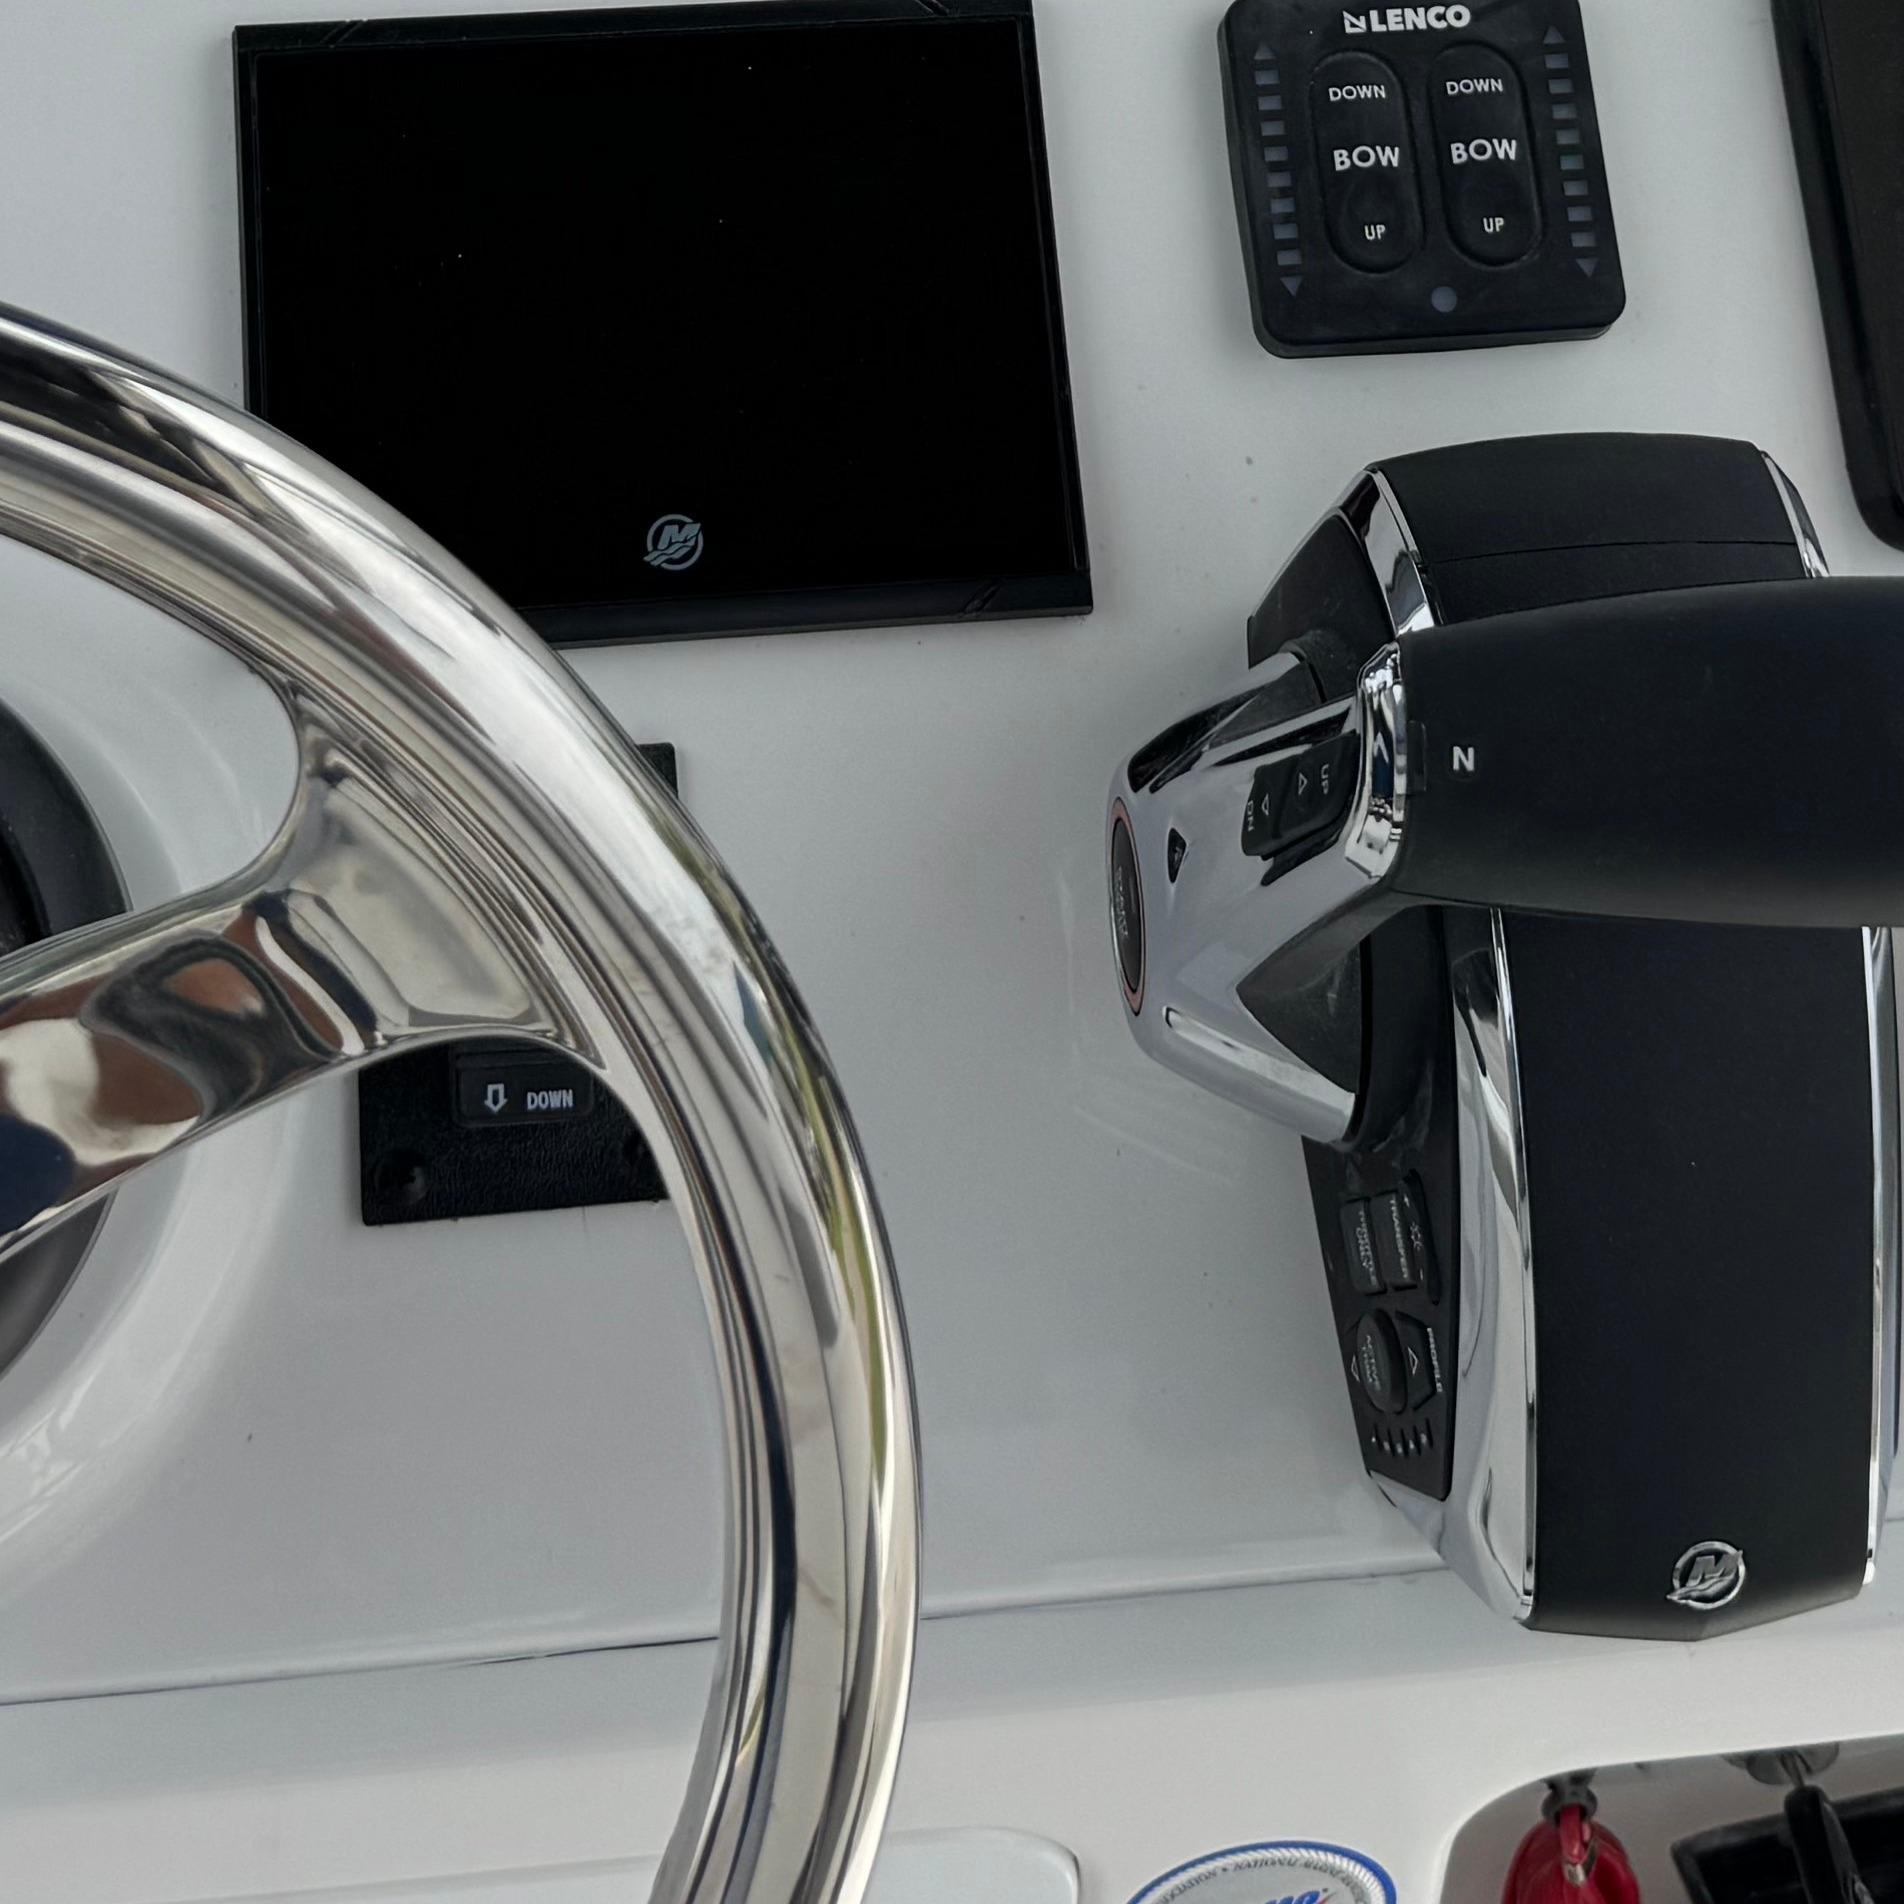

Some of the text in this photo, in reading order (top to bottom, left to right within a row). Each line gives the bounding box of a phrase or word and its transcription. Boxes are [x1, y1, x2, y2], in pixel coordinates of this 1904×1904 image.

[1371, 4, 1471, 33] LENCO
[1329, 84, 1386, 102] DOWN
[1446, 78, 1503, 95] DOWN
[1333, 145, 1399, 171] BOW
[1450, 138, 1516, 164] BOW
[1365, 224, 1386, 241] UP
[1482, 217, 1505, 233] UP
[1451, 745, 1476, 773] N
[1319, 763, 1331, 796] UP
[527, 1088, 573, 1110] DOWN
[1426, 1327, 1444, 1393] PROFILE
